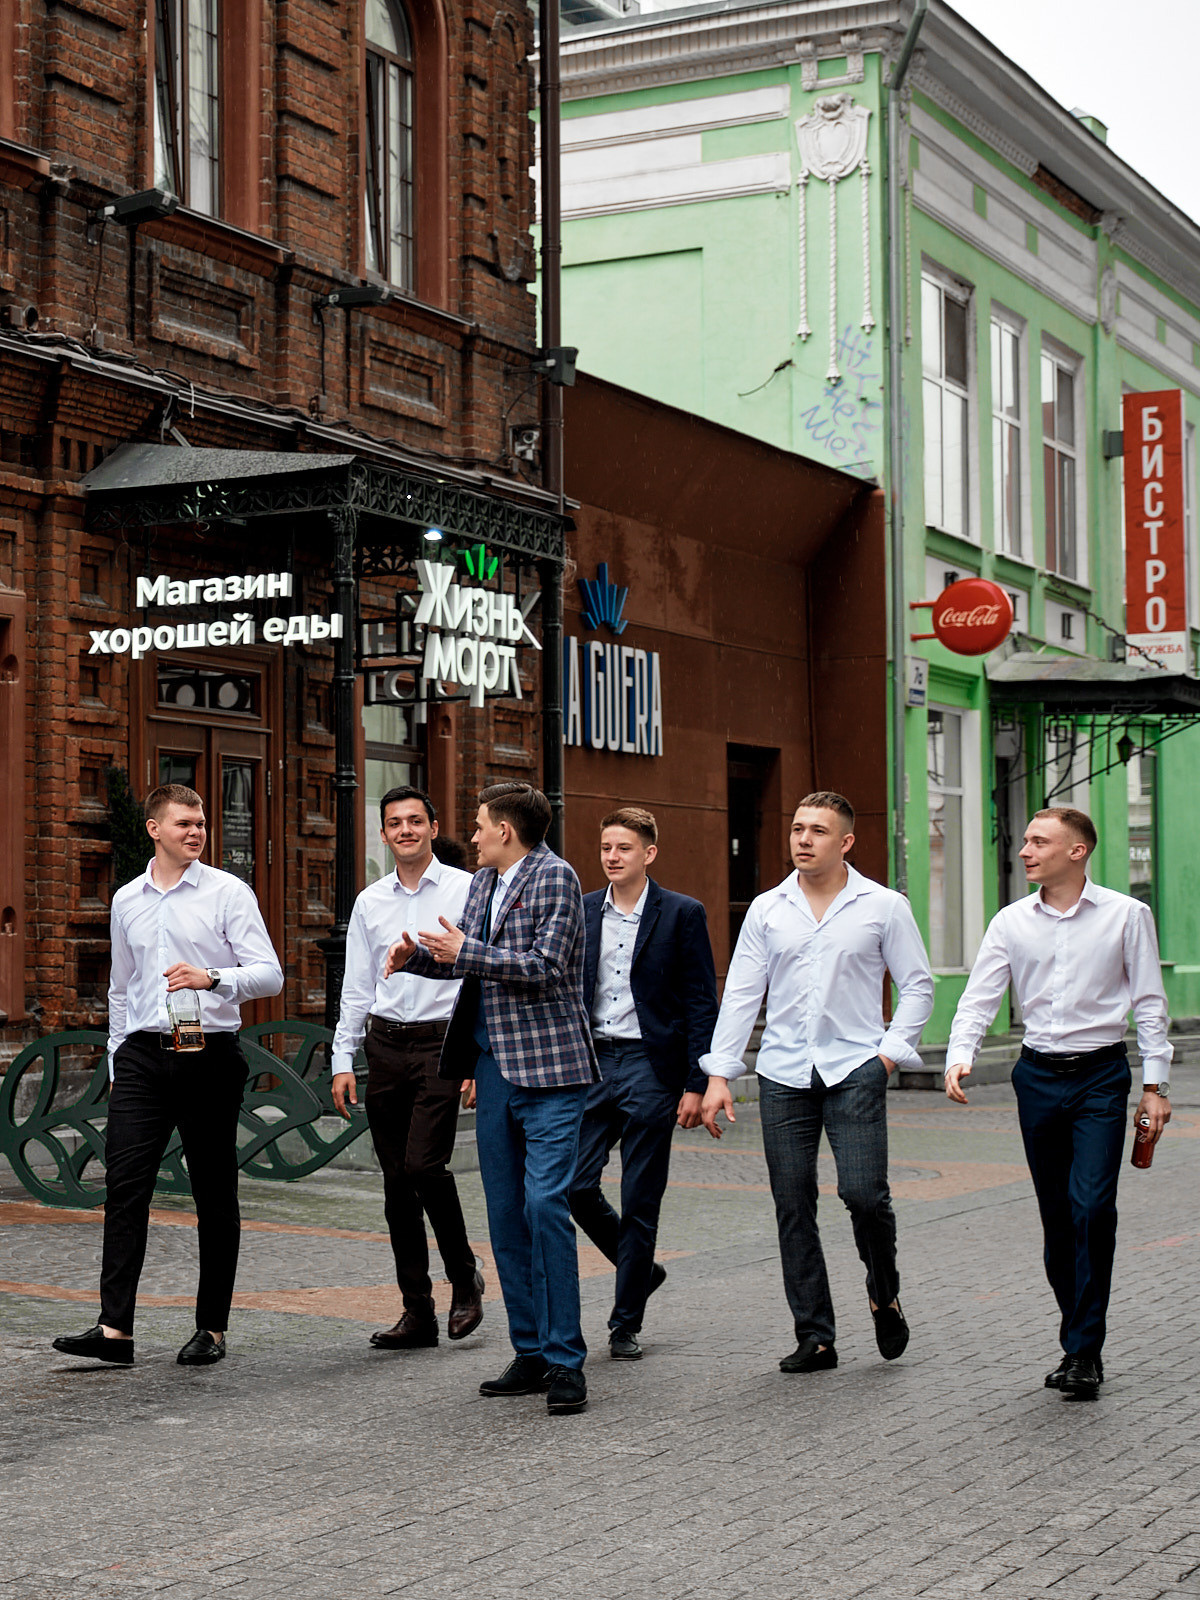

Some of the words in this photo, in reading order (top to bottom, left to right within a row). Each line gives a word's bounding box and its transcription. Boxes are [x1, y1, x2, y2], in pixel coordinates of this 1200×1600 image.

[1140, 405, 1168, 633] БИСТРО
[135, 571, 293, 608] Магазин
[414, 559, 526, 642] Жизнь
[88, 612, 256, 660] хорошей
[262, 612, 344, 648] еды
[586, 639, 664, 758] GUERA
